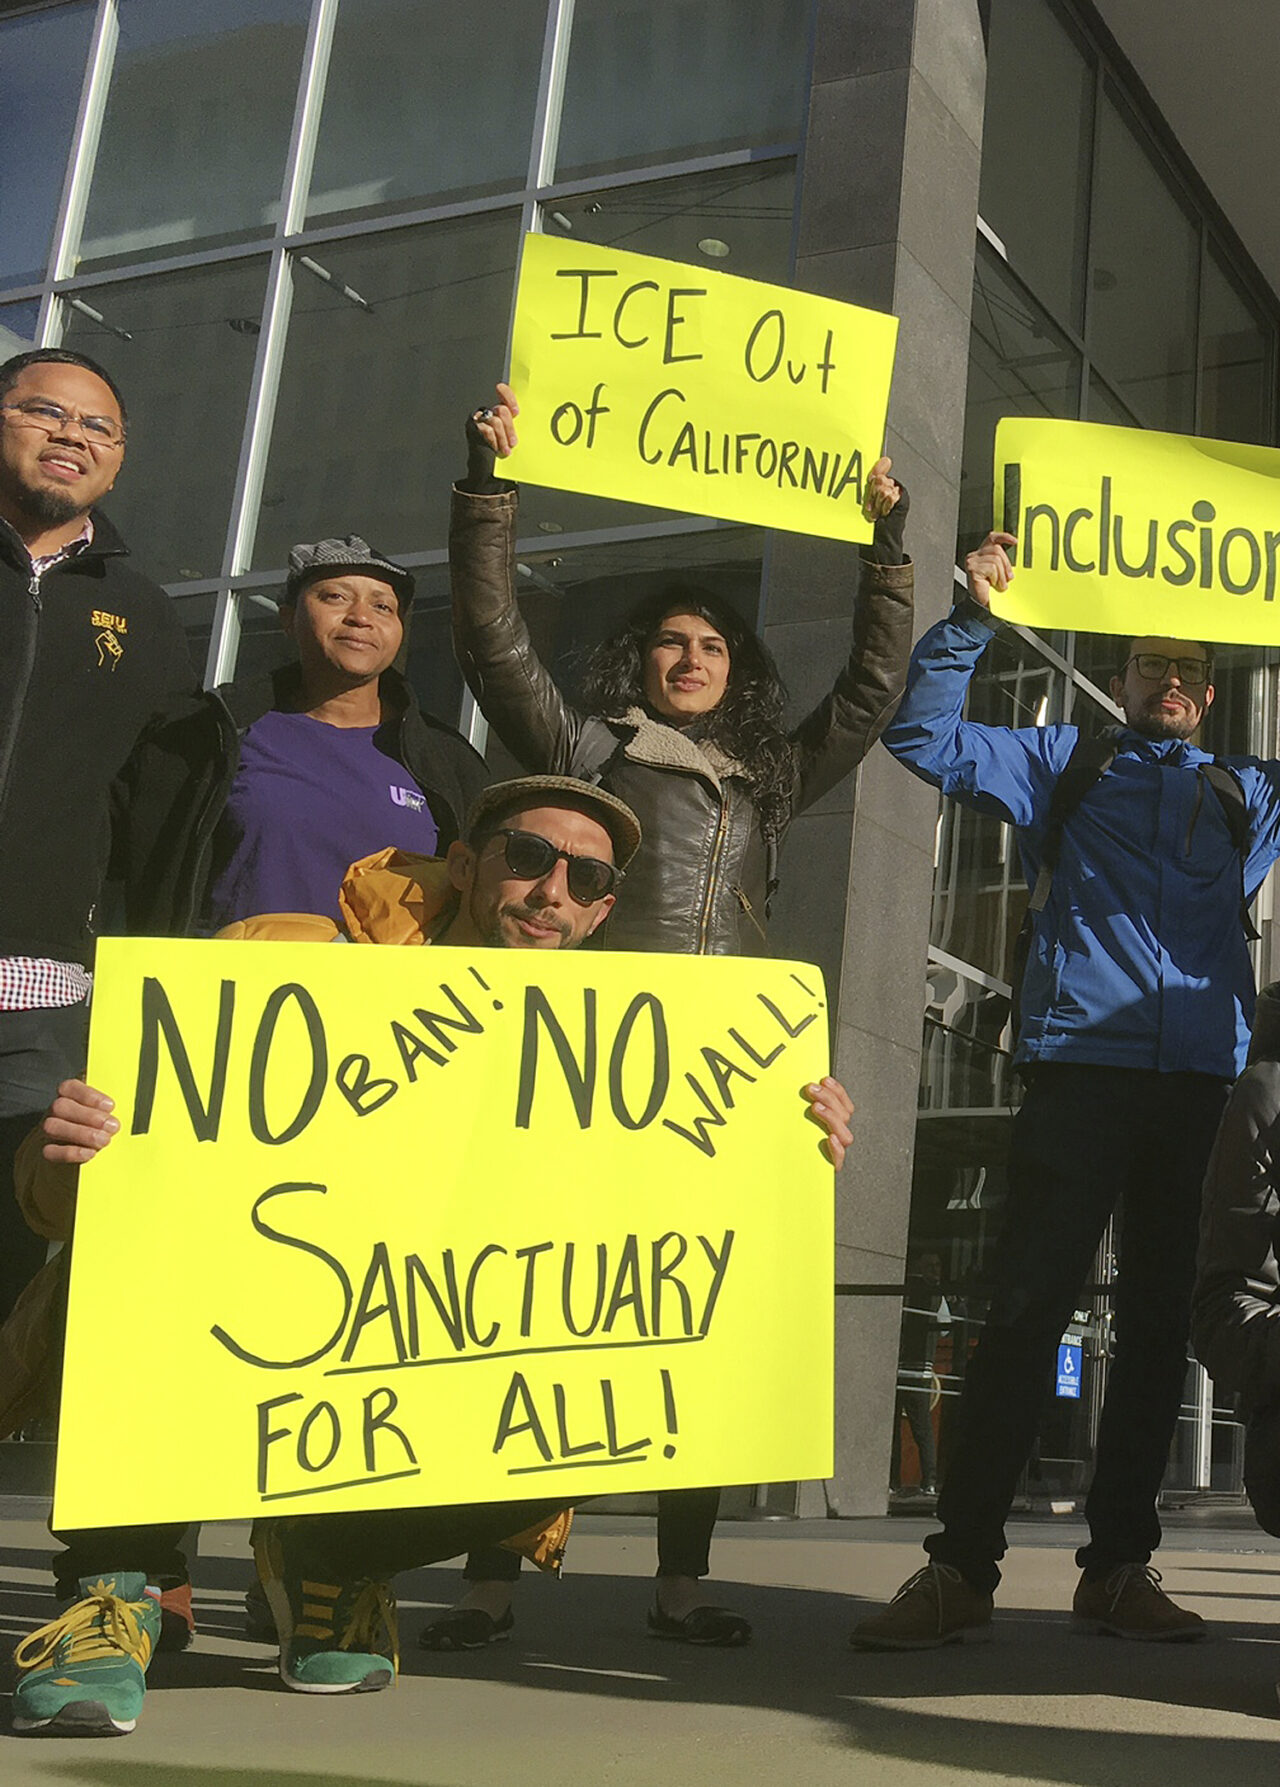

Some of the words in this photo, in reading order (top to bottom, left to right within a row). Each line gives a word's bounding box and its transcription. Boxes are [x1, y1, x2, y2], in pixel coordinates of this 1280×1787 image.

[550, 269, 707, 365] ICE
[745, 309, 836, 394] Out
[550, 382, 611, 449] of
[638, 388, 864, 506] CALIFORNIA
[130, 976, 329, 1146] NO
[336, 966, 505, 1118] BAN!
[514, 985, 670, 1131] NO
[662, 973, 825, 1159] WALL!
[210, 1181, 736, 1372] SANCTUARY
[256, 1386, 419, 1495] FOR
[492, 1368, 680, 1462] ALL!
